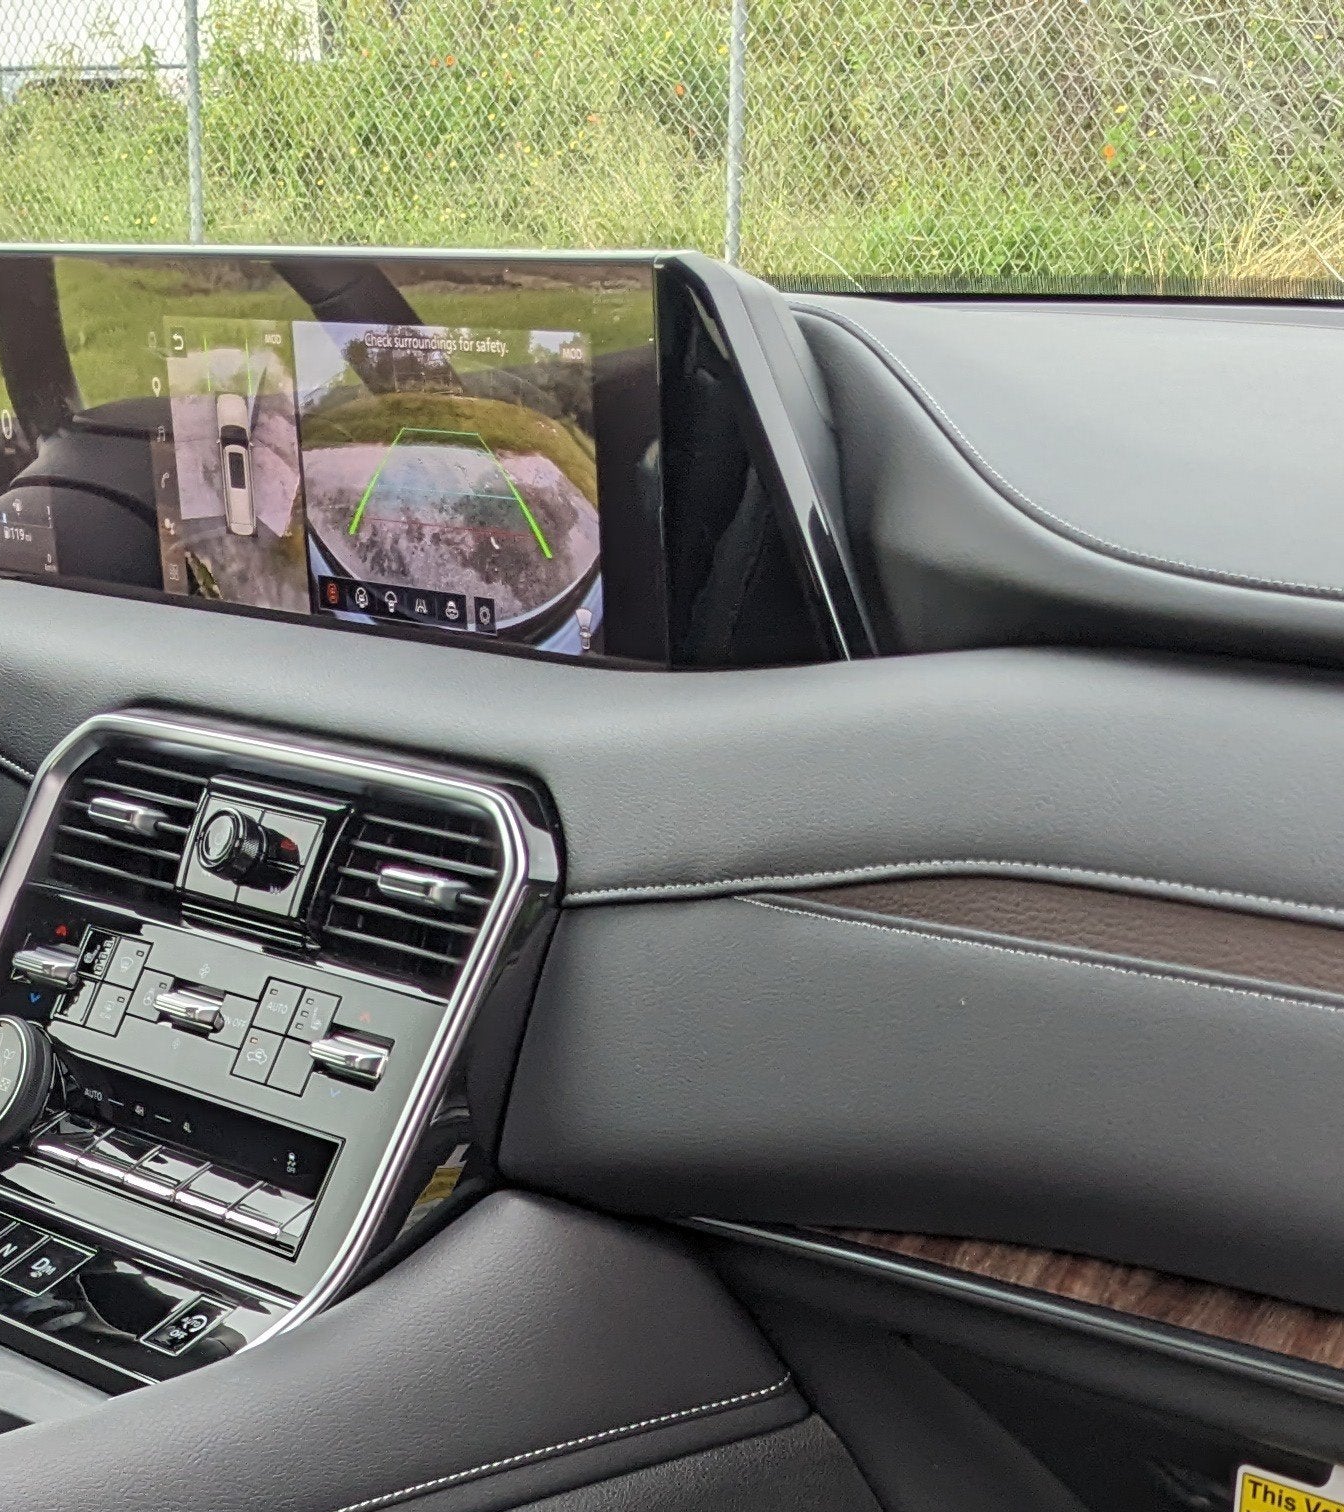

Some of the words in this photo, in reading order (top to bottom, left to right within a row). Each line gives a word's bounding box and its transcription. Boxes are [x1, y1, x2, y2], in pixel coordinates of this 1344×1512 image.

[364, 333, 392, 348] Check
[394, 335, 457, 354] surroundings
[459, 338, 474, 352] for
[476, 336, 510, 357] safety.
[266, 1001, 289, 1015] AUTO
[84, 1087, 103, 1101] AUTO
[1248, 1479, 1296, 1512] This
